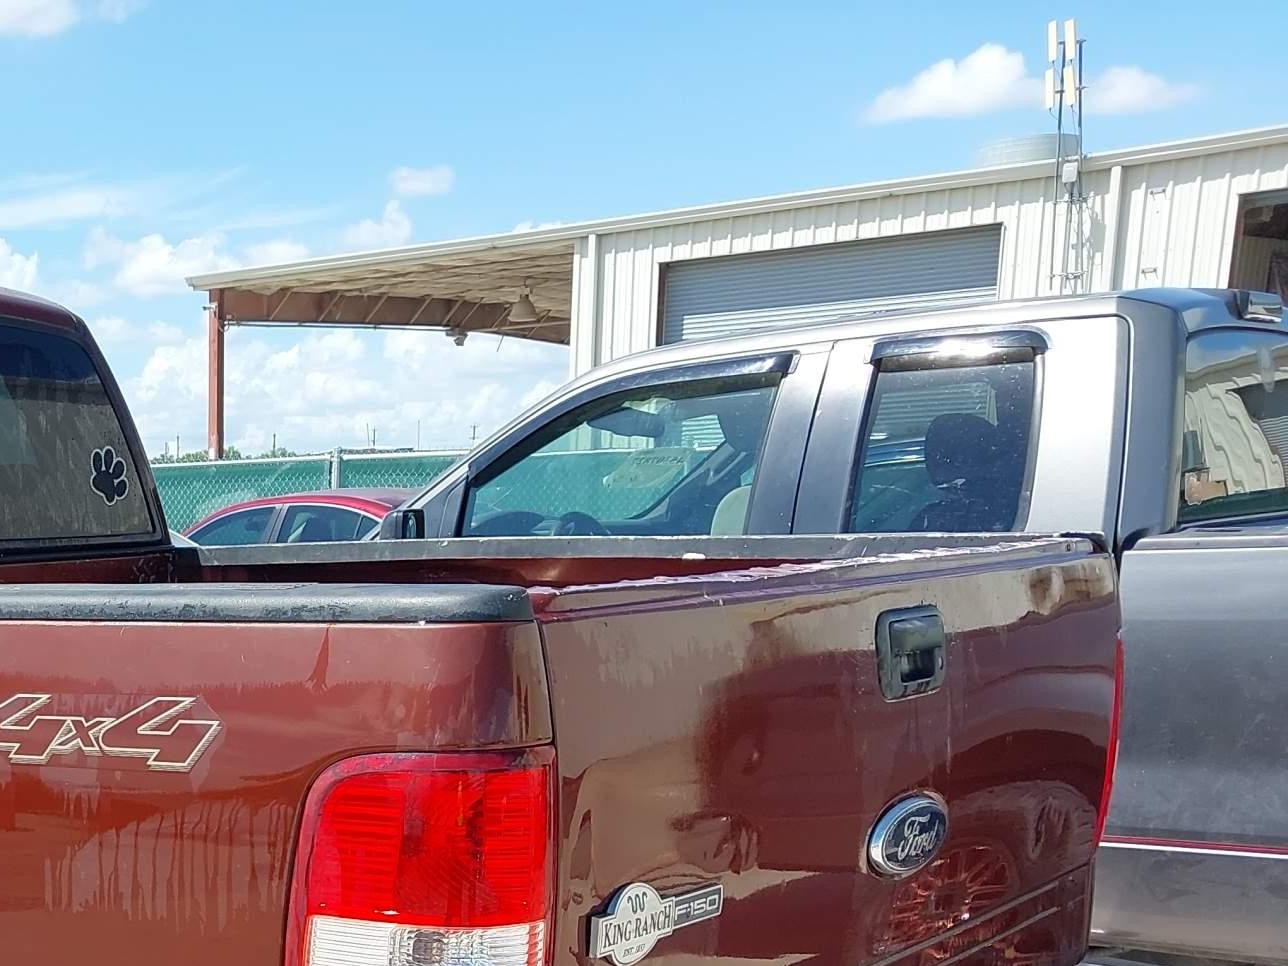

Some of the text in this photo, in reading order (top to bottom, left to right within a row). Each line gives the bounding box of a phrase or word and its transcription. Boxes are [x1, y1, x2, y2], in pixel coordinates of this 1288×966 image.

[897, 813, 940, 861] Ford
[603, 903, 673, 949] KING RANCH
[674, 894, 720, 921] F-150
